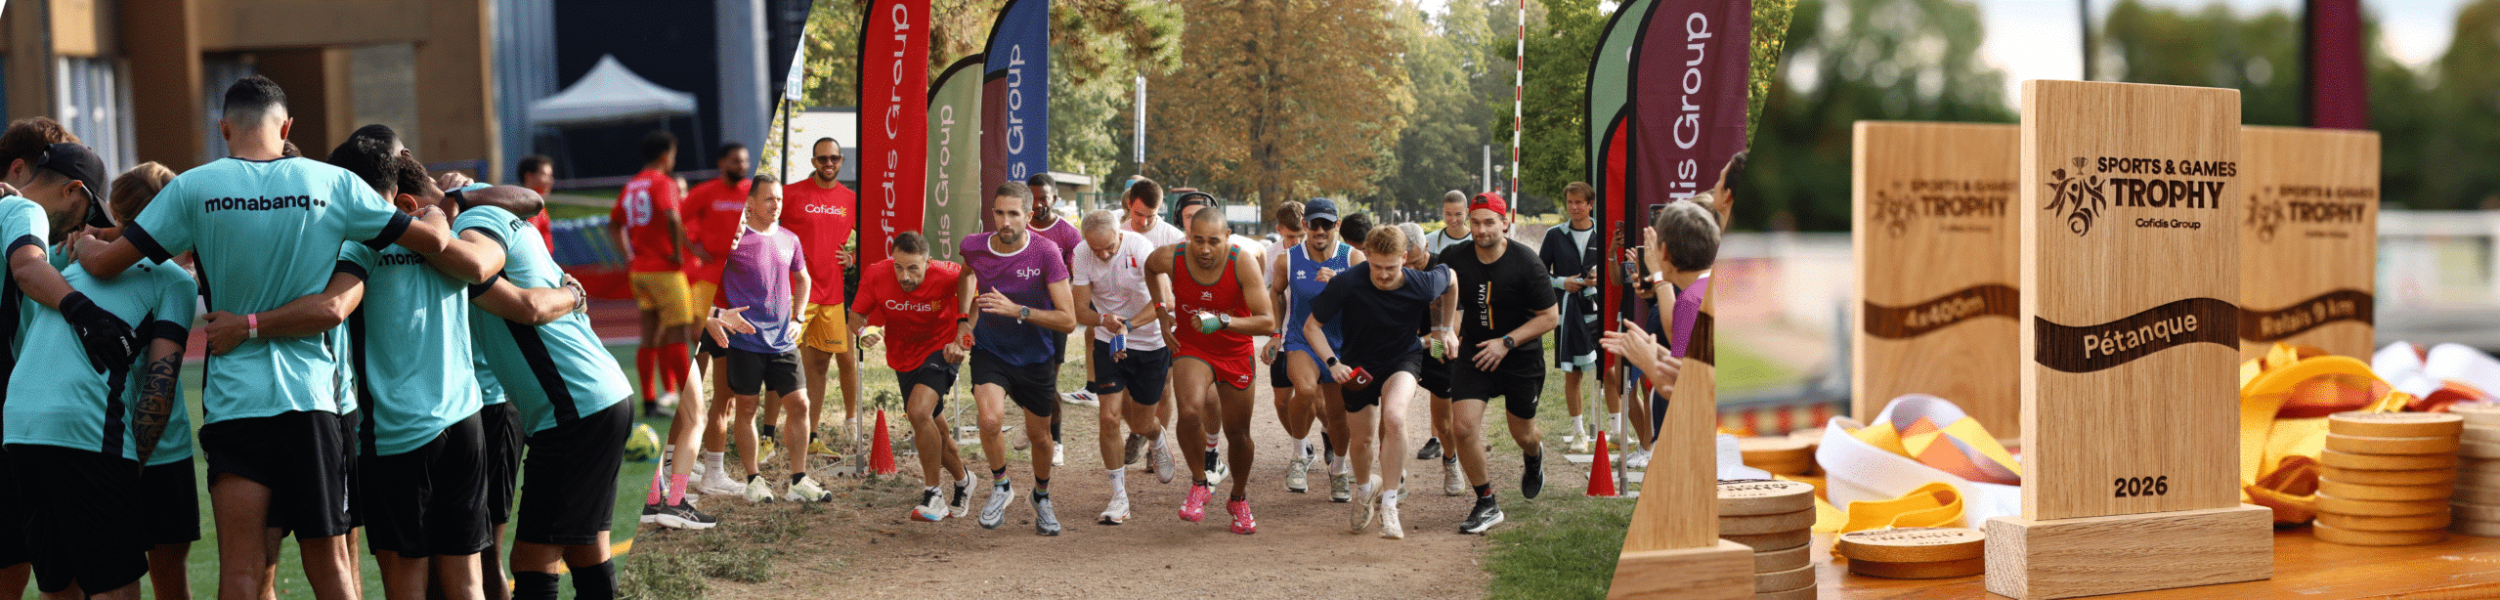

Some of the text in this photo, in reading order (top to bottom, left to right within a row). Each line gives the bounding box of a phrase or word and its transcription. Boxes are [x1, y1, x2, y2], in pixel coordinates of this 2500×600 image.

[885, 3, 910, 140] Group
[1673, 12, 1712, 150] Group
[1006, 44, 1026, 155] Group
[935, 104, 955, 207] Group
[2097, 156, 2237, 178] SPORTS & GAMES
[2109, 178, 2225, 209] TROPHY
[622, 188, 653, 227] 19
[804, 203, 842, 216] Cofidis
[1921, 195, 2008, 217] TROPHY
[2288, 201, 2366, 222] TROPHY
[2135, 217, 2201, 231] Cofidis Group
[1016, 266, 1041, 280] syho
[885, 299, 932, 312] Cofidis
[1478, 283, 1488, 327] BELGIUM
[2312, 301, 2326, 322] 9
[2083, 313, 2198, 359] Pétanque
[2114, 475, 2168, 498] 2026
